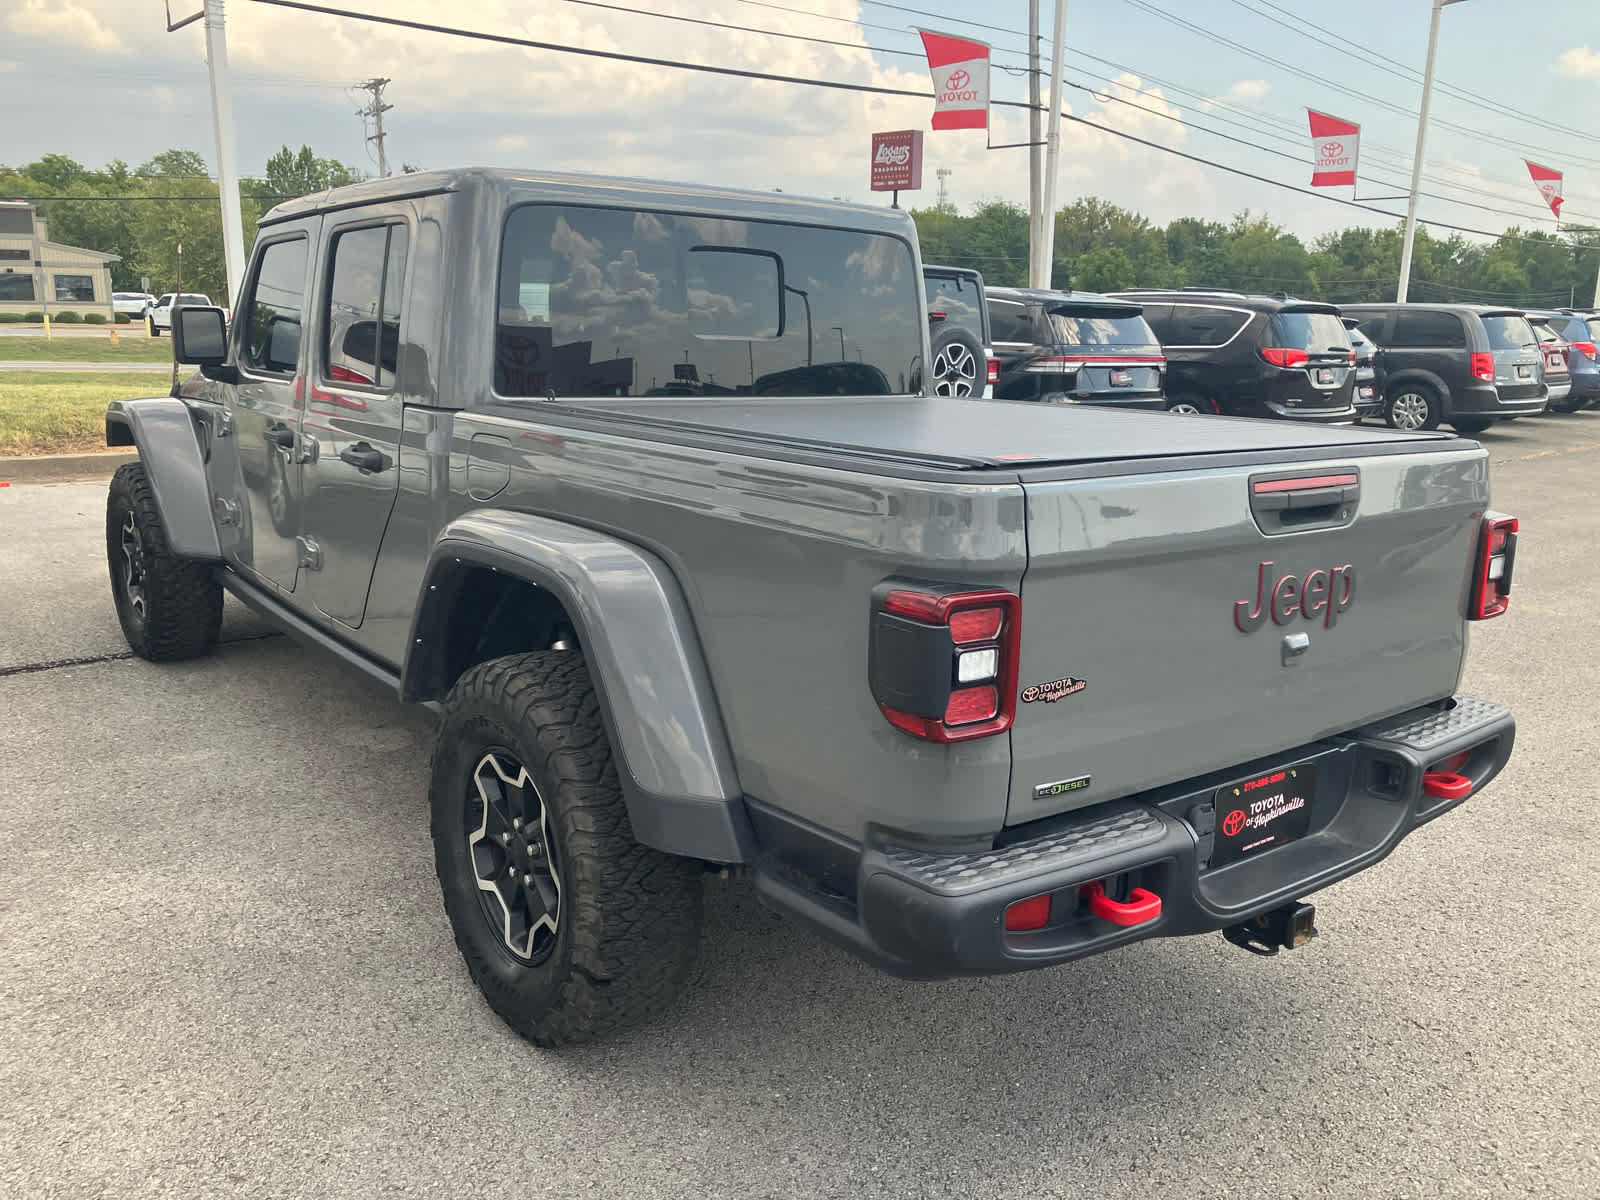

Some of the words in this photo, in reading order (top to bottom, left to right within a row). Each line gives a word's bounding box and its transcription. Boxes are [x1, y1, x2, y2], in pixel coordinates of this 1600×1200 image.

[1234, 561, 1355, 633] Jeep
[1040, 679, 1072, 693] TOYOTA
[1250, 793, 1285, 815] TOYOTA
[1253, 797, 1305, 829] Hopkinsville
